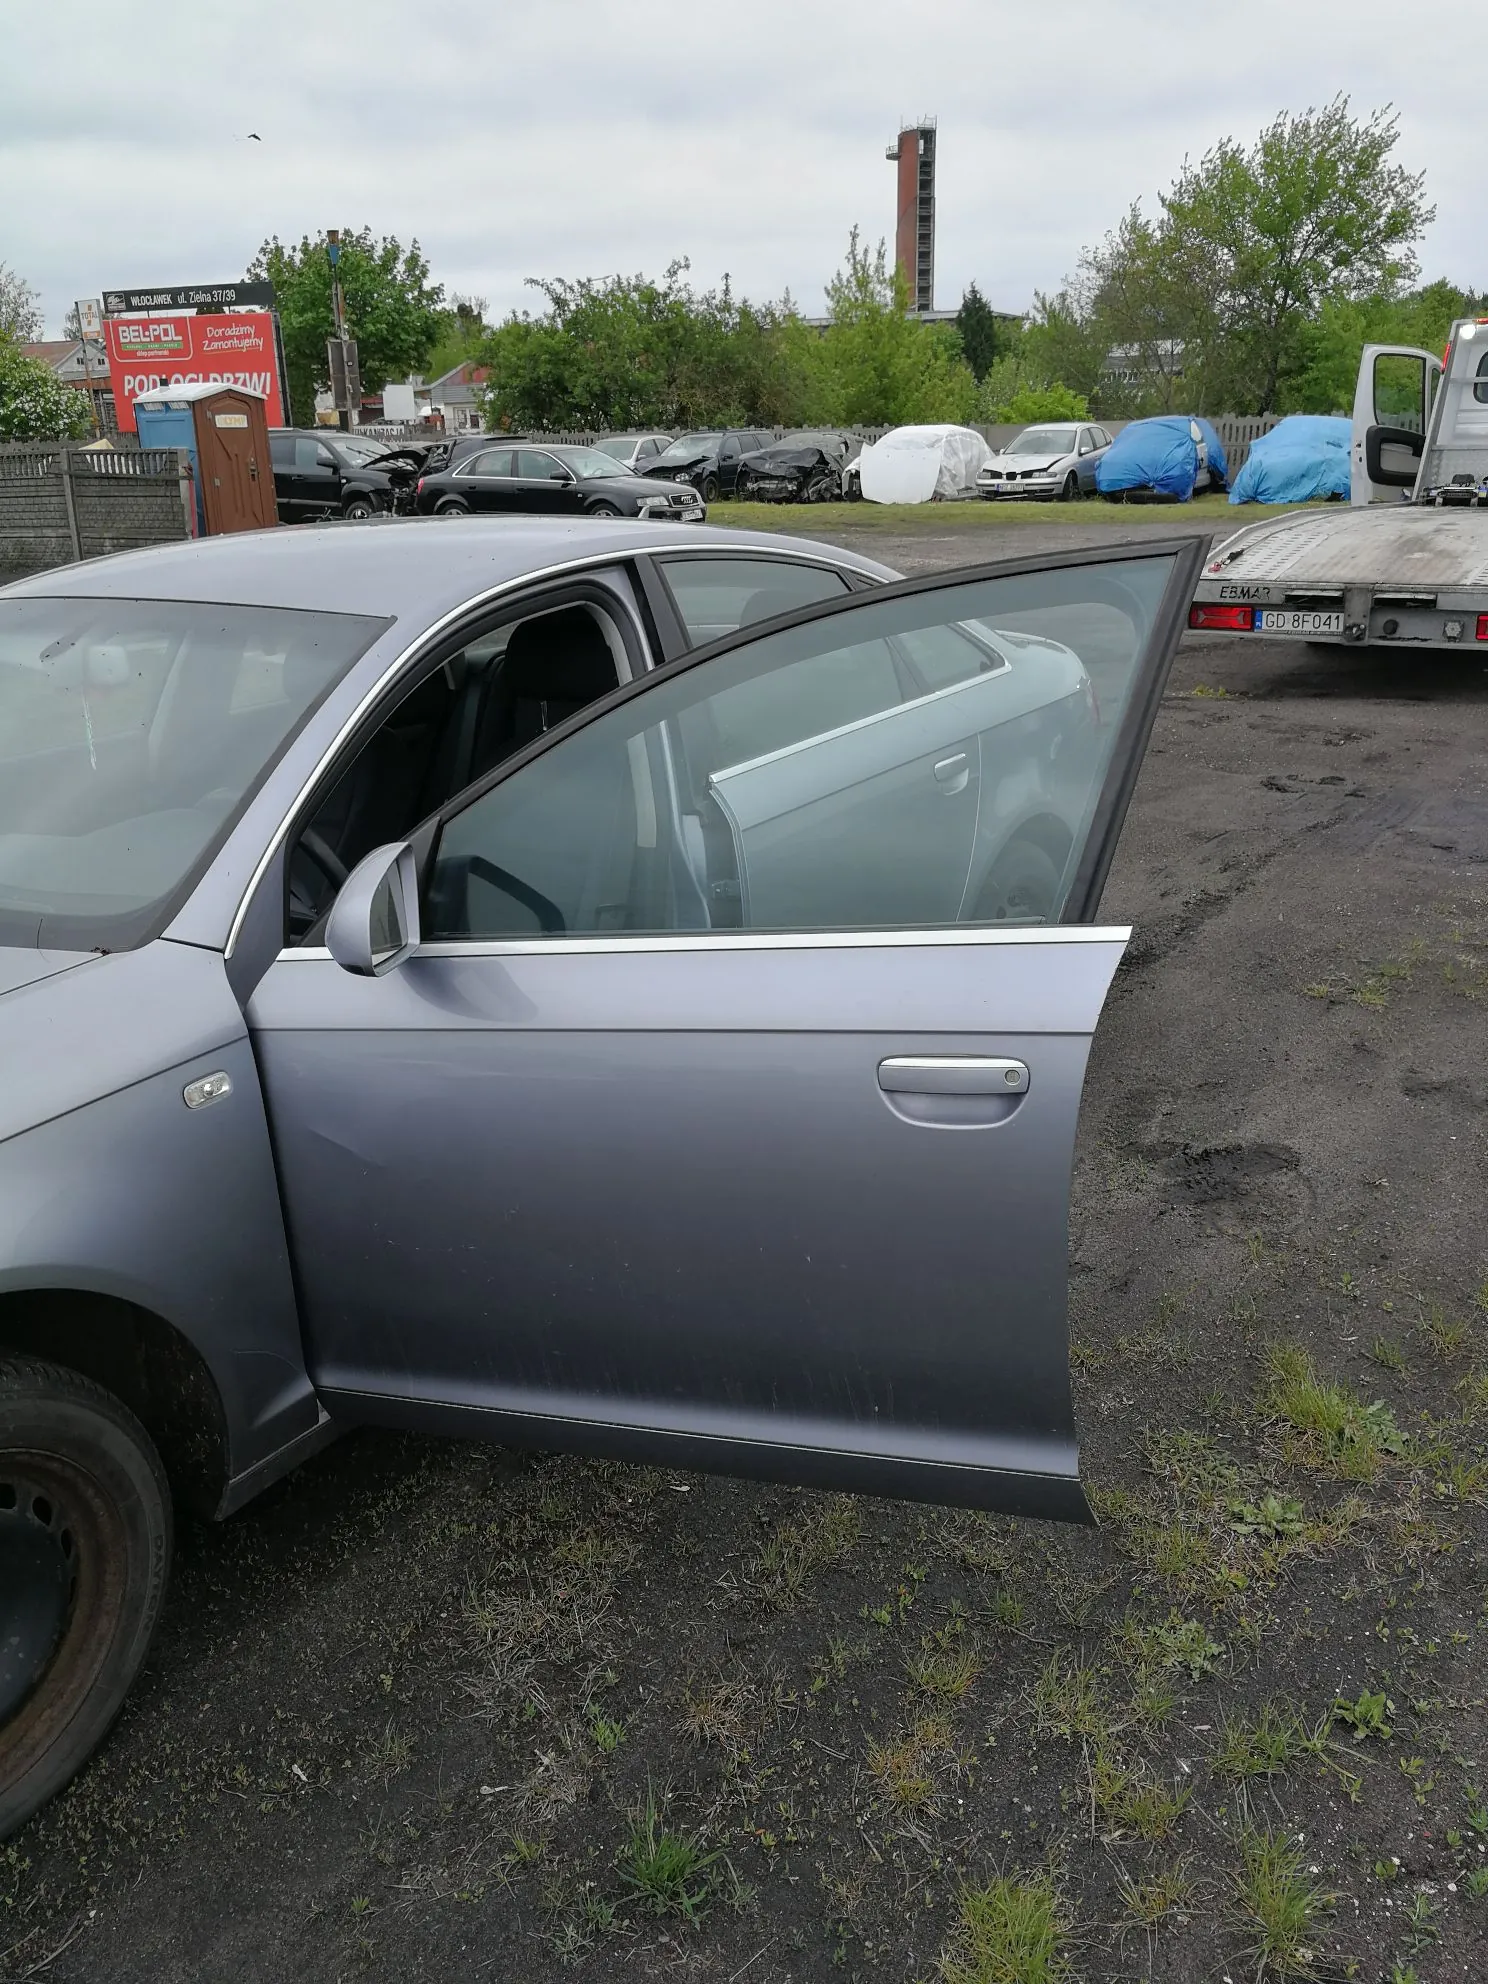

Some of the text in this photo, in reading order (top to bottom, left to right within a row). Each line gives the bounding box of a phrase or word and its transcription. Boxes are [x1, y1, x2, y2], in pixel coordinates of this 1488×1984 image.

[130, 294, 173, 307] WŁOCŁAWEK
[177, 292, 187, 305] ul.
[188, 291, 212, 304] Zielna
[212, 289, 236, 303] 37/39
[206, 323, 256, 338] Doradzimy
[202, 337, 264, 352] Zamontujemy
[1265, 612, 1341, 630] GD 8F041
